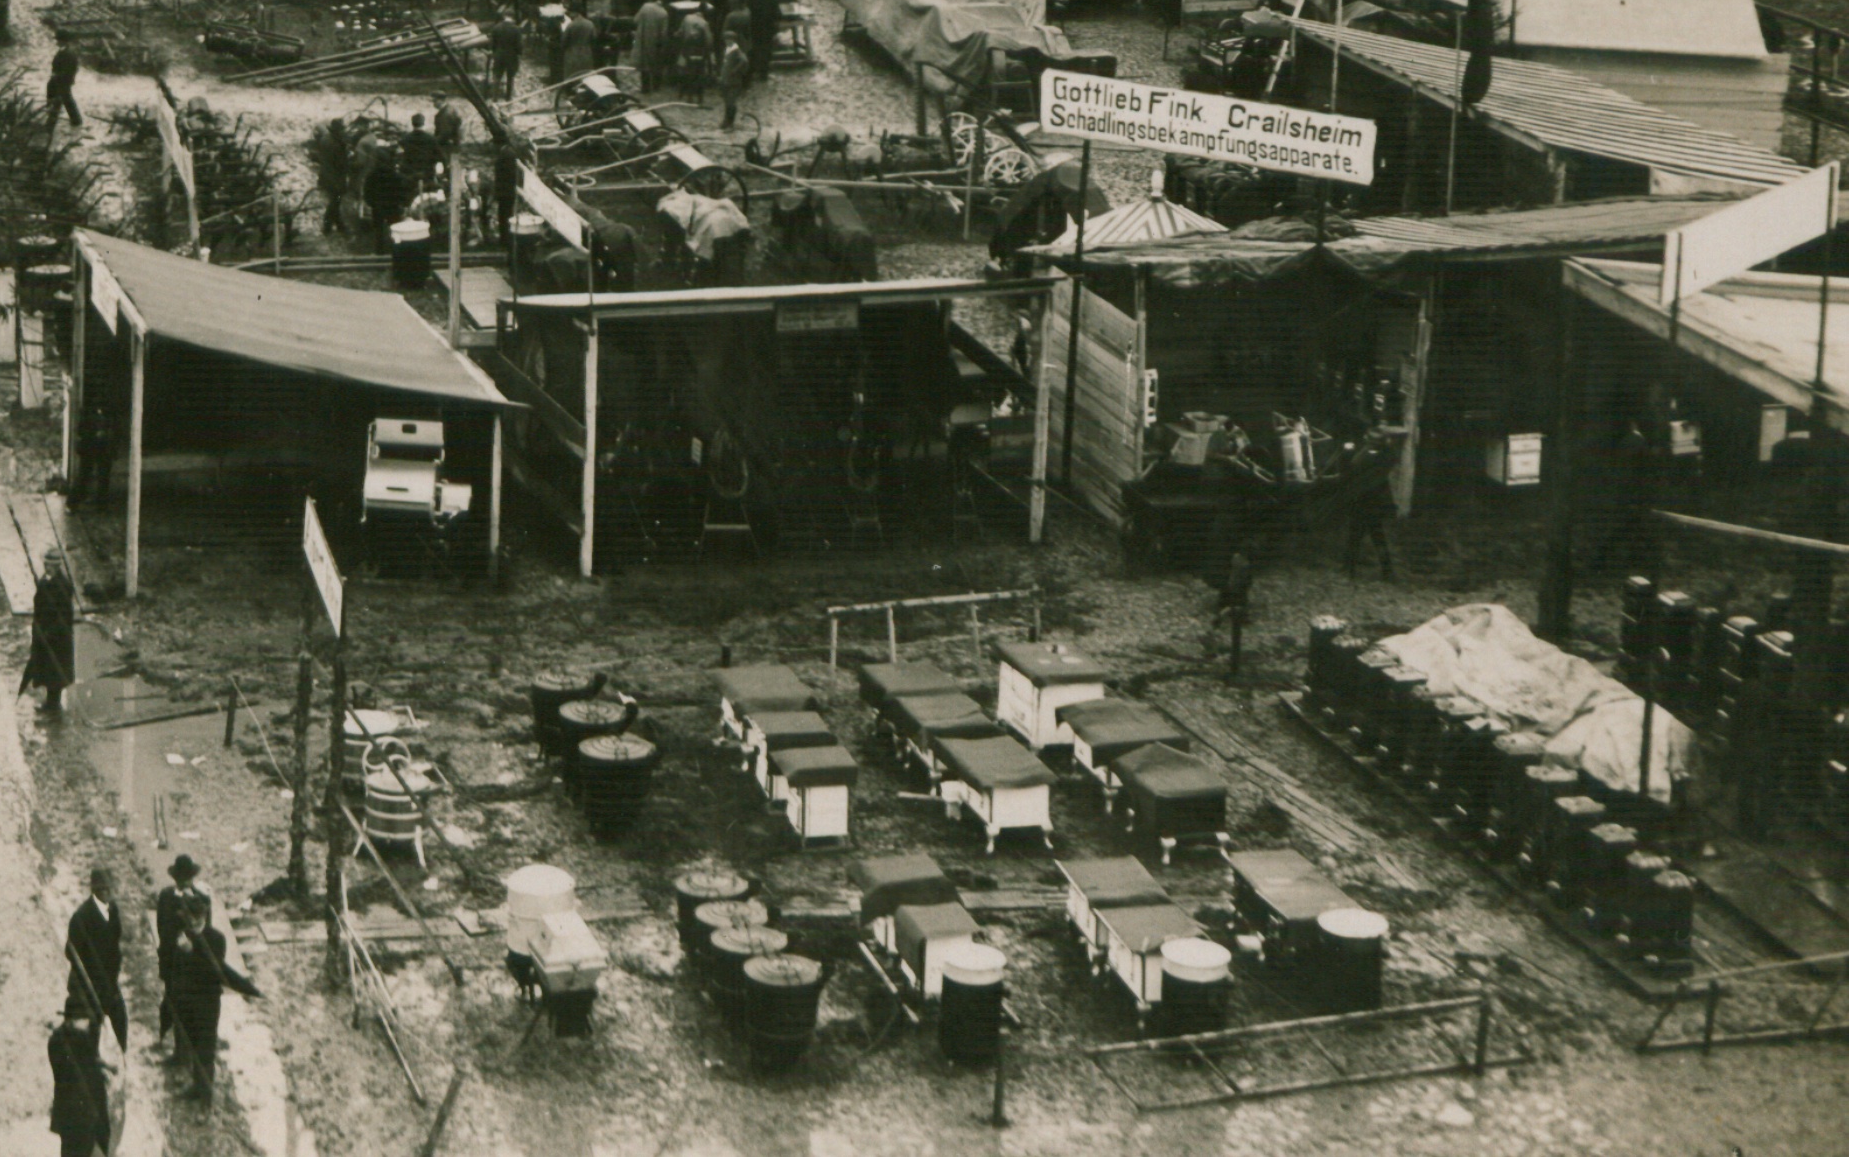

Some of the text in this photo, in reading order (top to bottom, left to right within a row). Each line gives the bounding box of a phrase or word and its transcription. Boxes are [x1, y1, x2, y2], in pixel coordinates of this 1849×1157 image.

[1050, 103, 1360, 175] Schädlingsbekämpfungsapparate.
[1053, 77, 1141, 113] Gottlieb
[1228, 103, 1364, 147] Crailsheim
